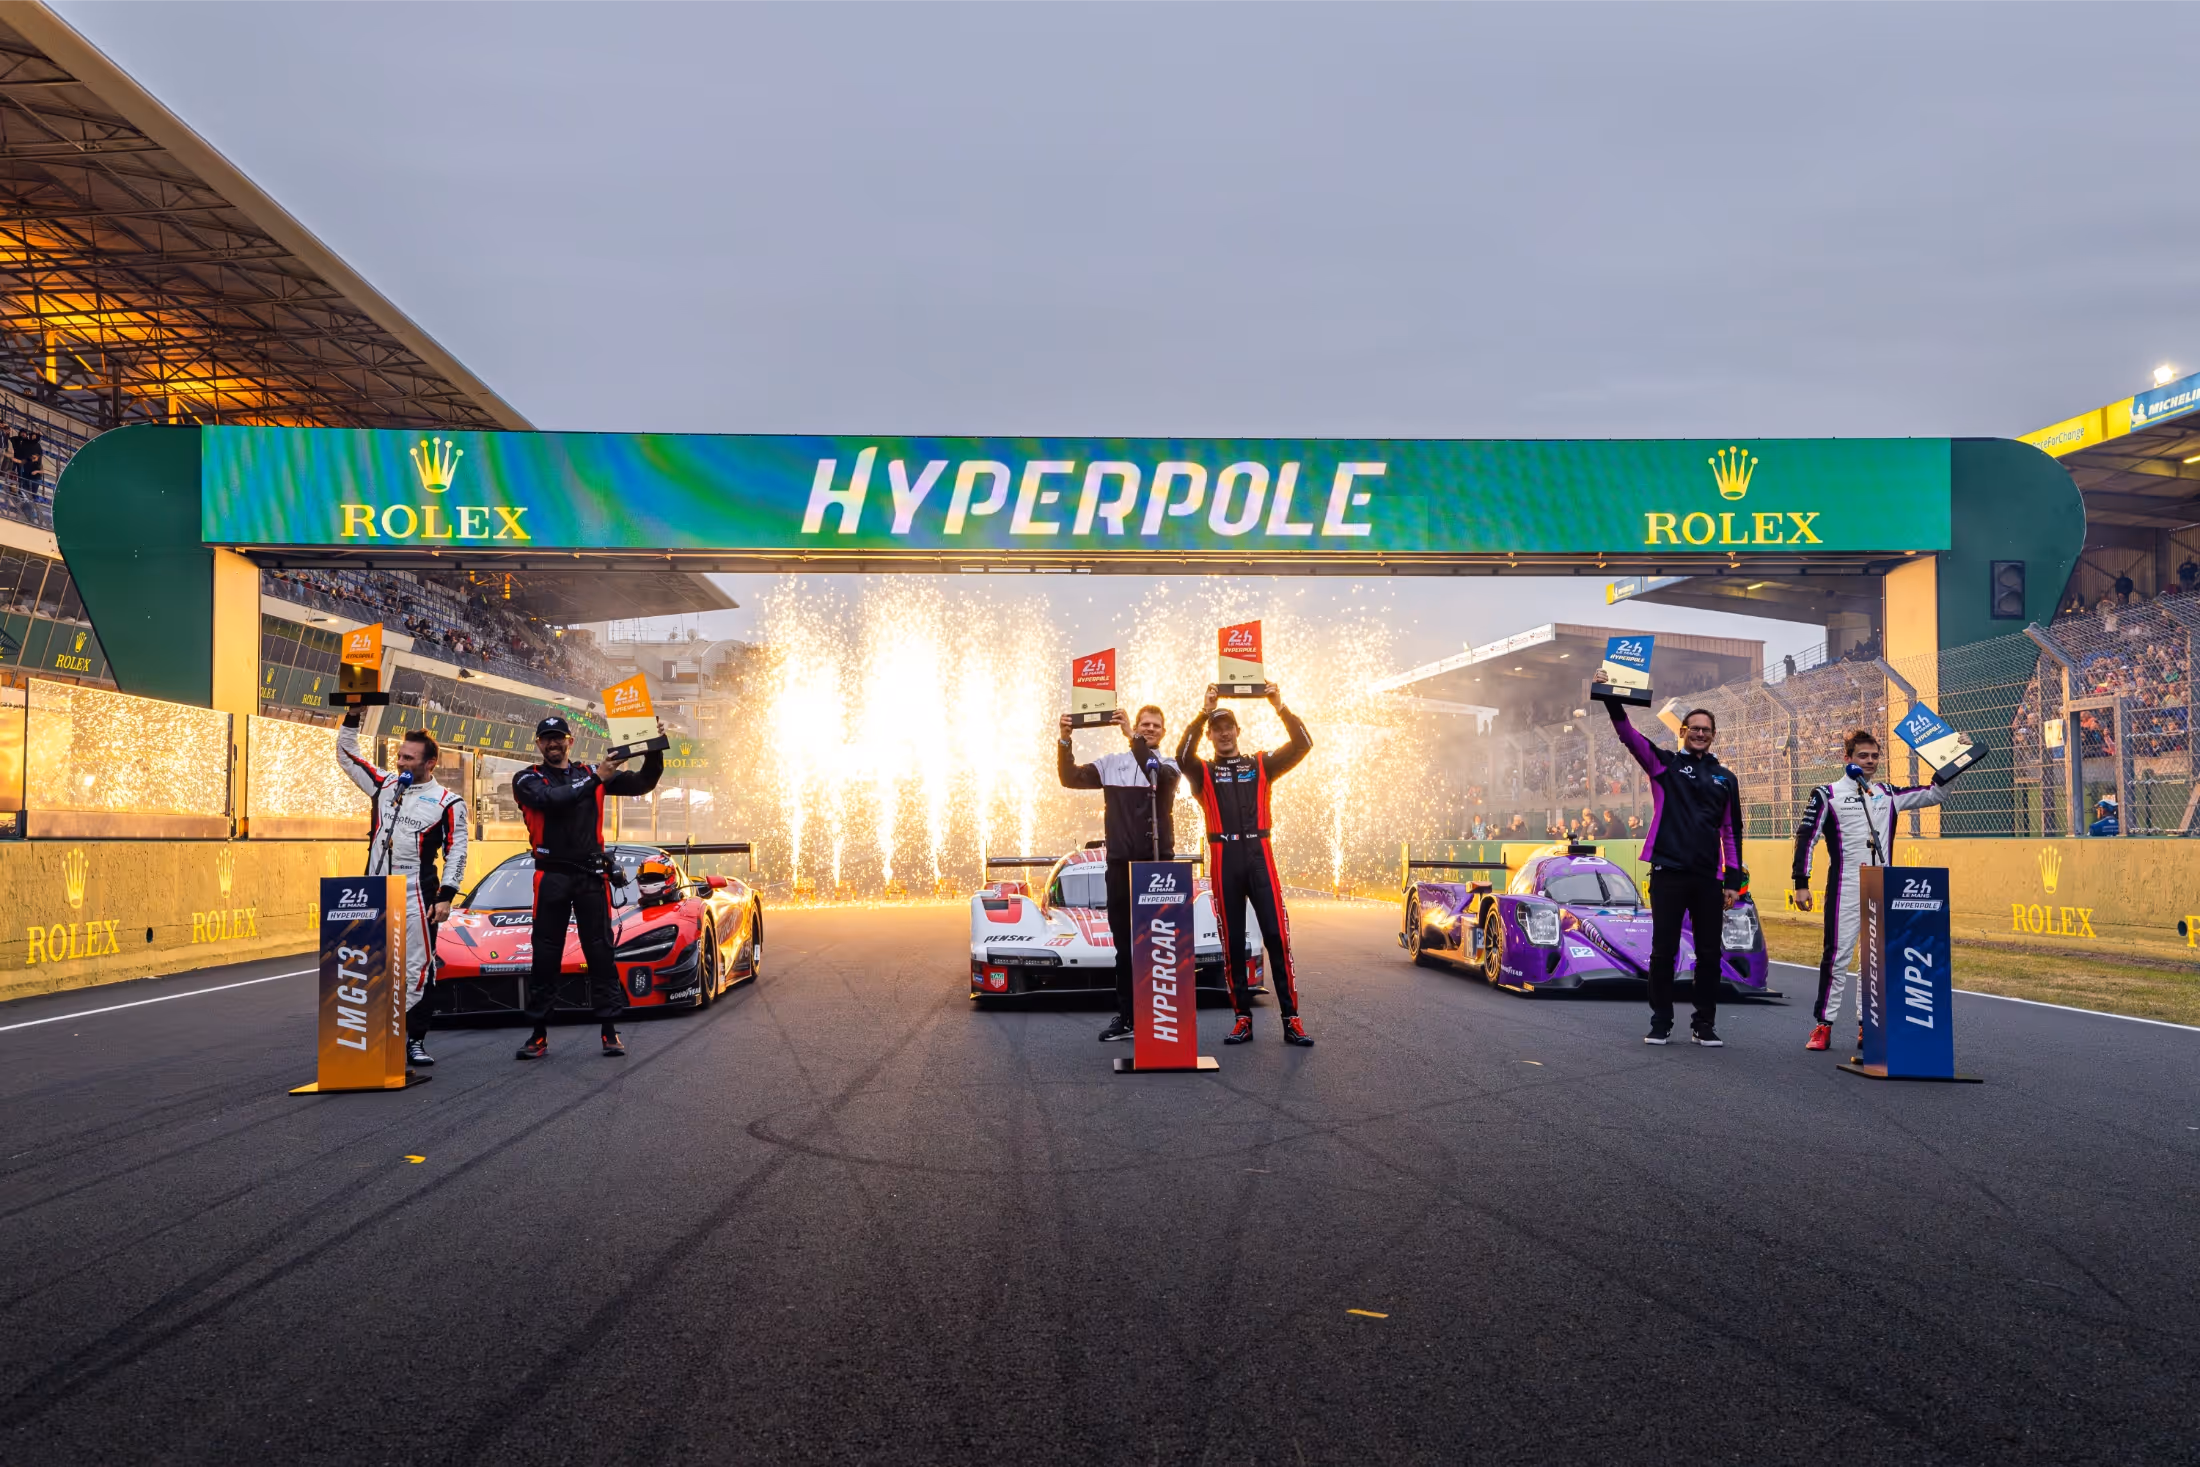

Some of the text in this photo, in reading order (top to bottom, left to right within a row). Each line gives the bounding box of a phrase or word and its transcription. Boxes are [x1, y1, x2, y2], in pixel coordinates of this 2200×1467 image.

[800, 447, 1387, 536] HYPERPOLE
[340, 504, 531, 539] ROLEX
[1644, 511, 1823, 545] ROLEX
[55, 654, 91, 672] ROLEX
[1610, 654, 1645, 663] HYPERPOLE
[261, 687, 277, 699] OLEX
[664, 759, 709, 768] ROLEX
[1150, 873, 1177, 888] 24h
[1903, 879, 1932, 894] 24h
[340, 888, 369, 904] 24h
[1894, 901, 1938, 909] HYPERPOLE
[191, 907, 257, 944] ROLEX
[330, 911, 374, 919] HYPERPOLE
[2011, 903, 2097, 939] ROLEX
[25, 919, 121, 965] ROLEX
[984, 935, 1035, 943] PENSKE
[1572, 947, 1593, 956] P2
[392, 908, 401, 1036] HYPERPOLE
[1868, 898, 1879, 1027] HYPERPOLE
[1151, 918, 1178, 1043] HYPERCAR
[1903, 947, 1934, 1029] LMP2
[336, 946, 369, 1051] LMGT3
